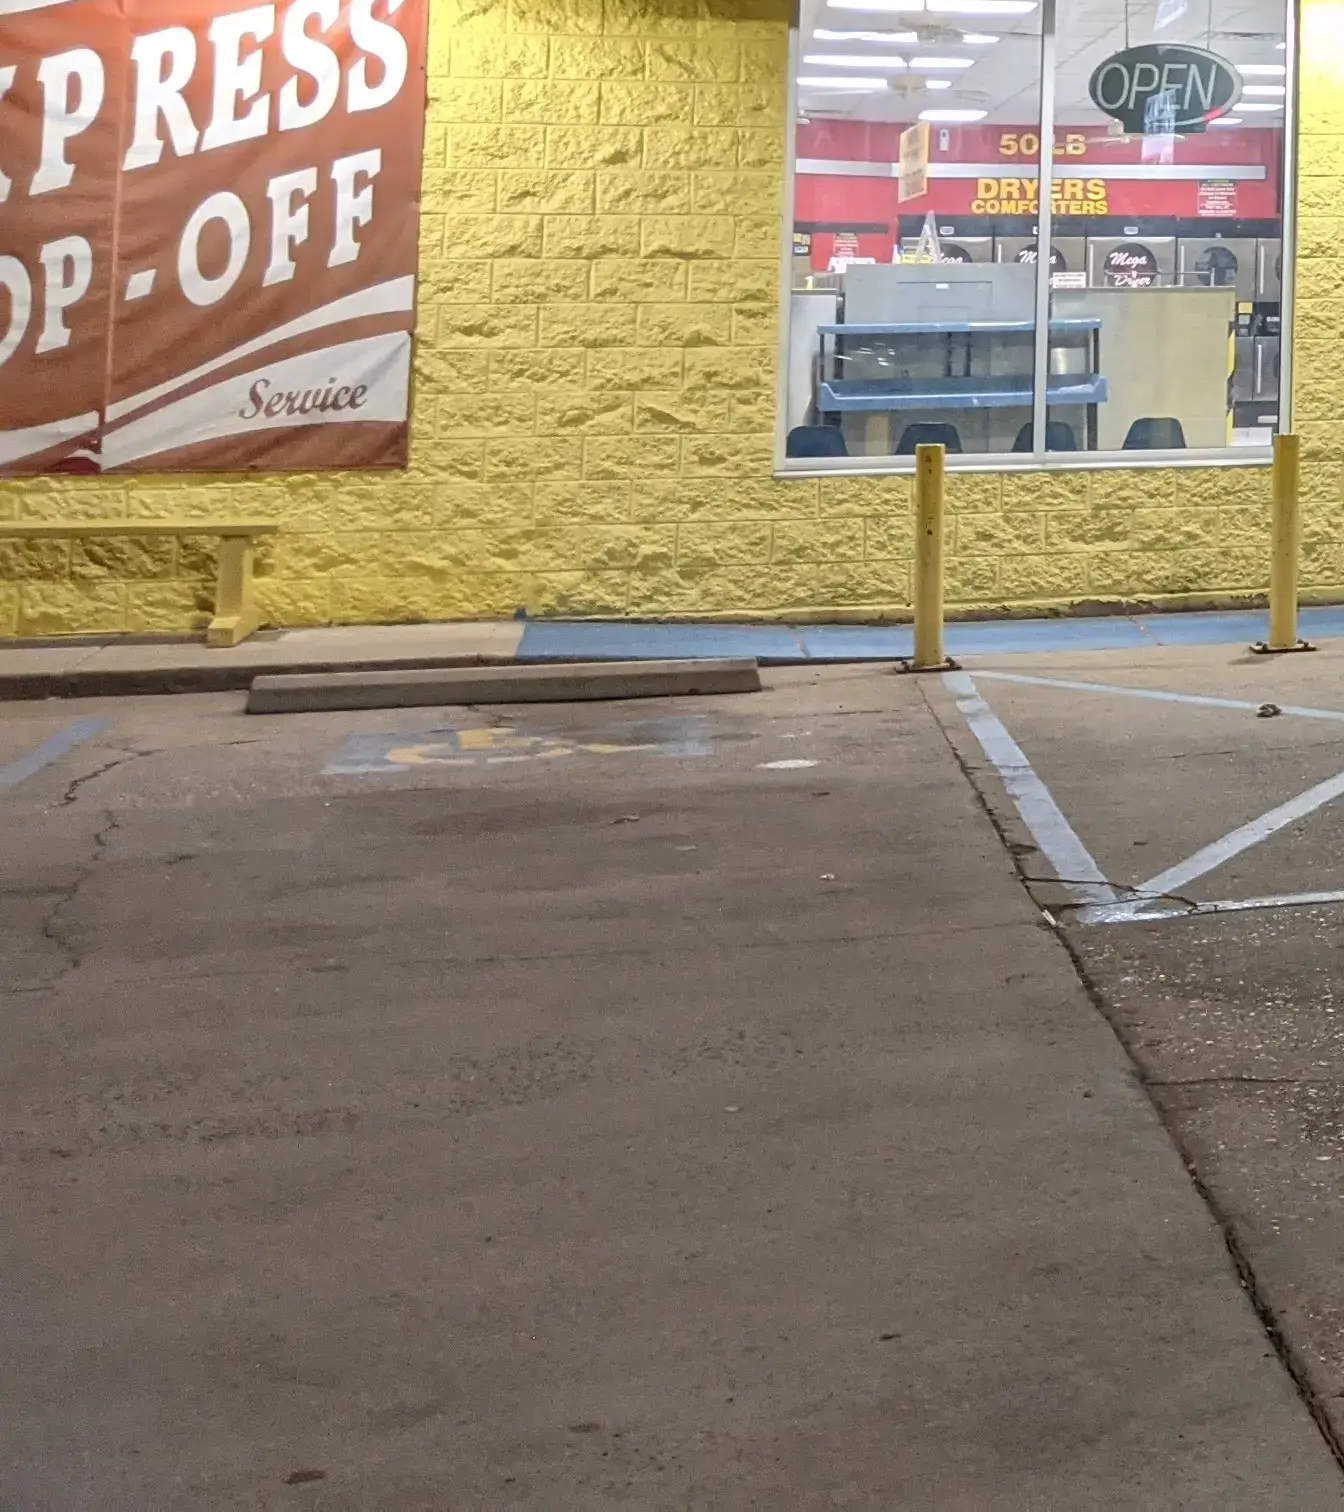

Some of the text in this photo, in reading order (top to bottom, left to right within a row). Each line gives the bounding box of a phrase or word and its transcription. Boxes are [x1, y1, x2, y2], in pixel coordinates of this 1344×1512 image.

[1096, 62, 1218, 110] OPEN
[999, 133, 1039, 155] 50
[977, 178, 1107, 199] DRYERS
[1109, 251, 1147, 269] Mega
[239, 378, 369, 421] Service
